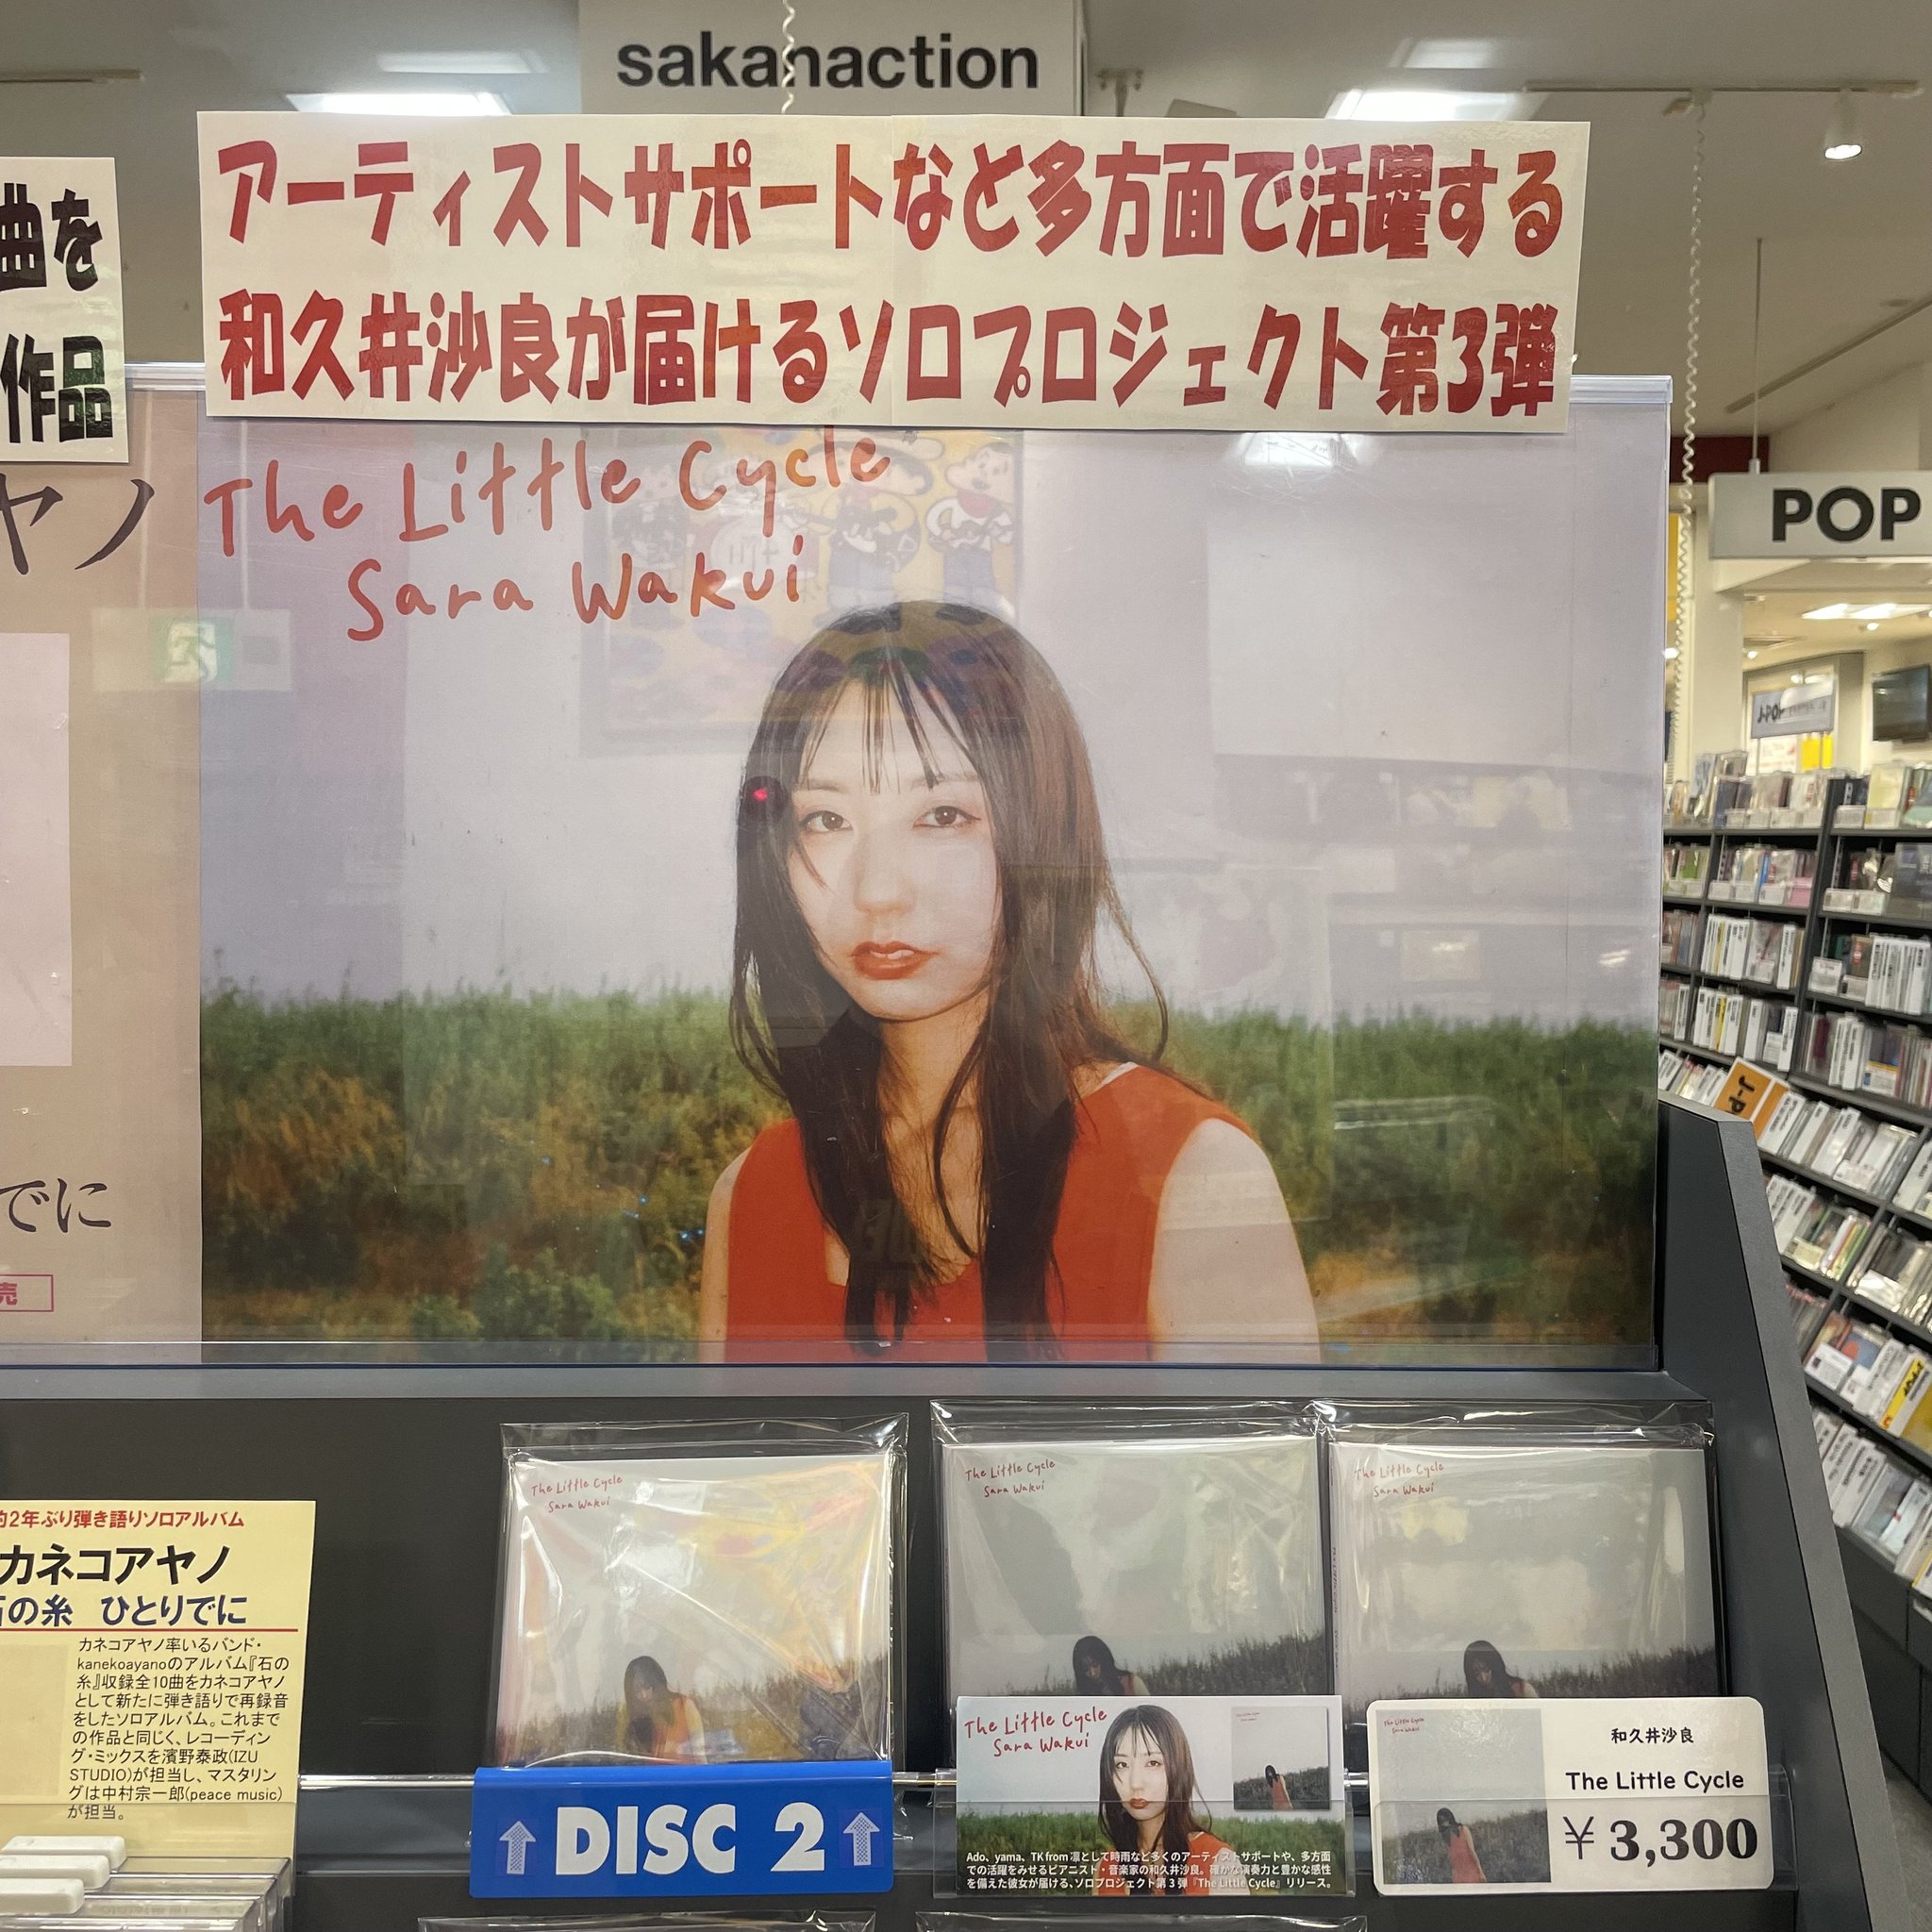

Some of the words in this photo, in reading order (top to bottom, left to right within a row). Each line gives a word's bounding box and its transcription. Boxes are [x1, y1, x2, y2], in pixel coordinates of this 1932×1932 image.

[617, 30, 1039, 89] sakanaction
[218, 139, 1563, 259] アーティストサポートなど多方面で活躍する
[218, 289, 1558, 417] 和久井沙良が届けるソロプロジェクト第3弾
[0, 334, 113, 442] 作品
[204, 460, 363, 557] The
[403, 438, 641, 542] Little
[679, 426, 890, 539] Cycle
[1772, 486, 1922, 542] POP
[347, 558, 534, 643] Sara
[571, 535, 802, 626] Wakui
[0, 1178, 112, 1234] でに
[965, 1467, 987, 1481] The
[991, 1462, 1023, 1479] Little
[1026, 1458, 1056, 1476] Cycle
[1354, 1467, 1375, 1480] The
[1379, 1463, 1411, 1478] Little
[1416, 1461, 1444, 1478] Cycle
[531, 1483, 553, 1496] The
[556, 1478, 590, 1494] Little
[593, 1474, 623, 1491] Cycle
[984, 1485, 1008, 1498] Sara
[1013, 1480, 1045, 1494] Wakui
[1374, 1485, 1399, 1498] Sara
[1402, 1482, 1434, 1495] Wakui
[548, 1500, 574, 1513] Sara
[577, 1496, 609, 1509] Wakui
[0, 1542, 230, 1586] カネコアヤノ
[0, 1594, 74, 1627] の糸
[100, 1594, 247, 1626] ひとりでに
[77, 1656, 290, 1673] kanekoayanoのアルバム『石の
[76, 1674, 285, 1690] 糸』収録全10曲をカネコアヤノ
[75, 1692, 289, 1709] として新たに弾き語りで再録音
[74, 1710, 280, 1727] をしたソロアルバム。これまで
[964, 1718, 998, 1740] The
[1003, 1711, 1056, 1737] Little
[1061, 1706, 1108, 1734] Cycle
[73, 1729, 271, 1746] の作品と同じく、レコーディン
[993, 1738, 1033, 1757] Sara
[1040, 1733, 1090, 1753] Wakui
[1610, 1727, 1694, 1744] 和久井沙良
[70, 1767, 277, 1783] STUDIO)が担当し、マスタリン
[1565, 1772, 1608, 1790] The
[1616, 1771, 1675, 1790] Little
[1683, 1770, 1745, 1793] Cycle
[237, 1786, 283, 1803] music)
[67, 1804, 125, 1821] が担当。
[555, 1803, 737, 1875] DISC
[770, 1801, 825, 1873] 2
